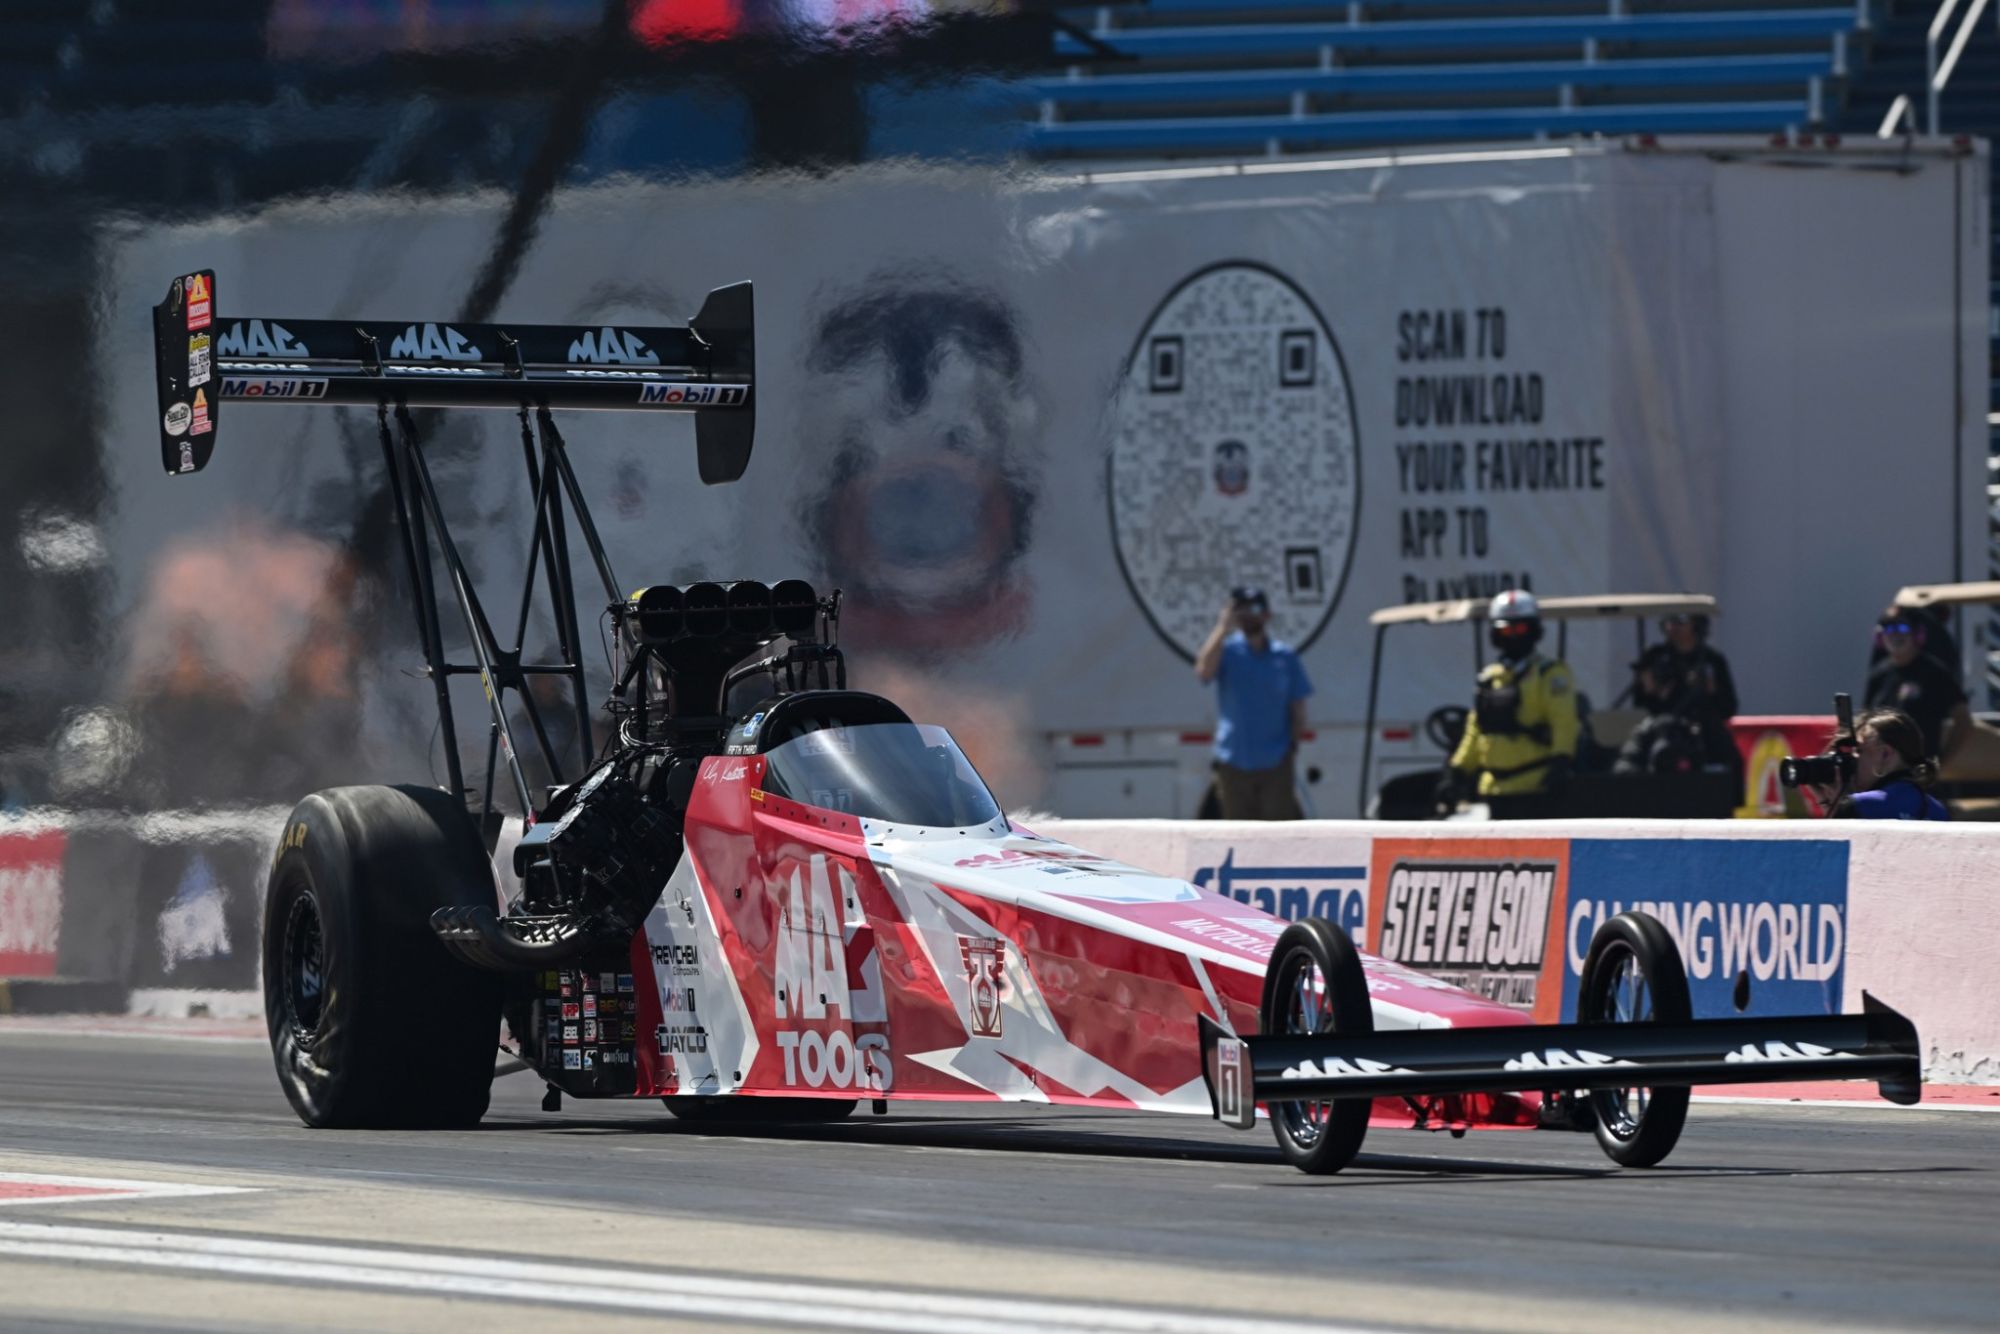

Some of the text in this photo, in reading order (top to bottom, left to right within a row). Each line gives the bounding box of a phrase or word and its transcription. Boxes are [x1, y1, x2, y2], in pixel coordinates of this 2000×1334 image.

[217, 319, 310, 357] MAC
[390, 323, 482, 361] MAC
[568, 327, 660, 365] MAC
[1397, 306, 1506, 361] SCAN TO
[222, 378, 295, 397] Mobil
[643, 385, 716, 402] Mobil
[1396, 372, 1543, 426] DOWNLOAD
[1396, 438, 1605, 492] YOUR FAVORITE
[1400, 507, 1489, 559] APP TO
[728, 745, 742, 755] FIFTH
[1193, 847, 1367, 948] tnge
[1381, 868, 1553, 965] STEVENSON
[775, 853, 888, 1023] MAC
[1568, 898, 1843, 981] CANG WORLD
[662, 987, 687, 1011] Mobil
[656, 1025, 710, 1054] DAYCO
[776, 1030, 894, 1091] TOOLS
